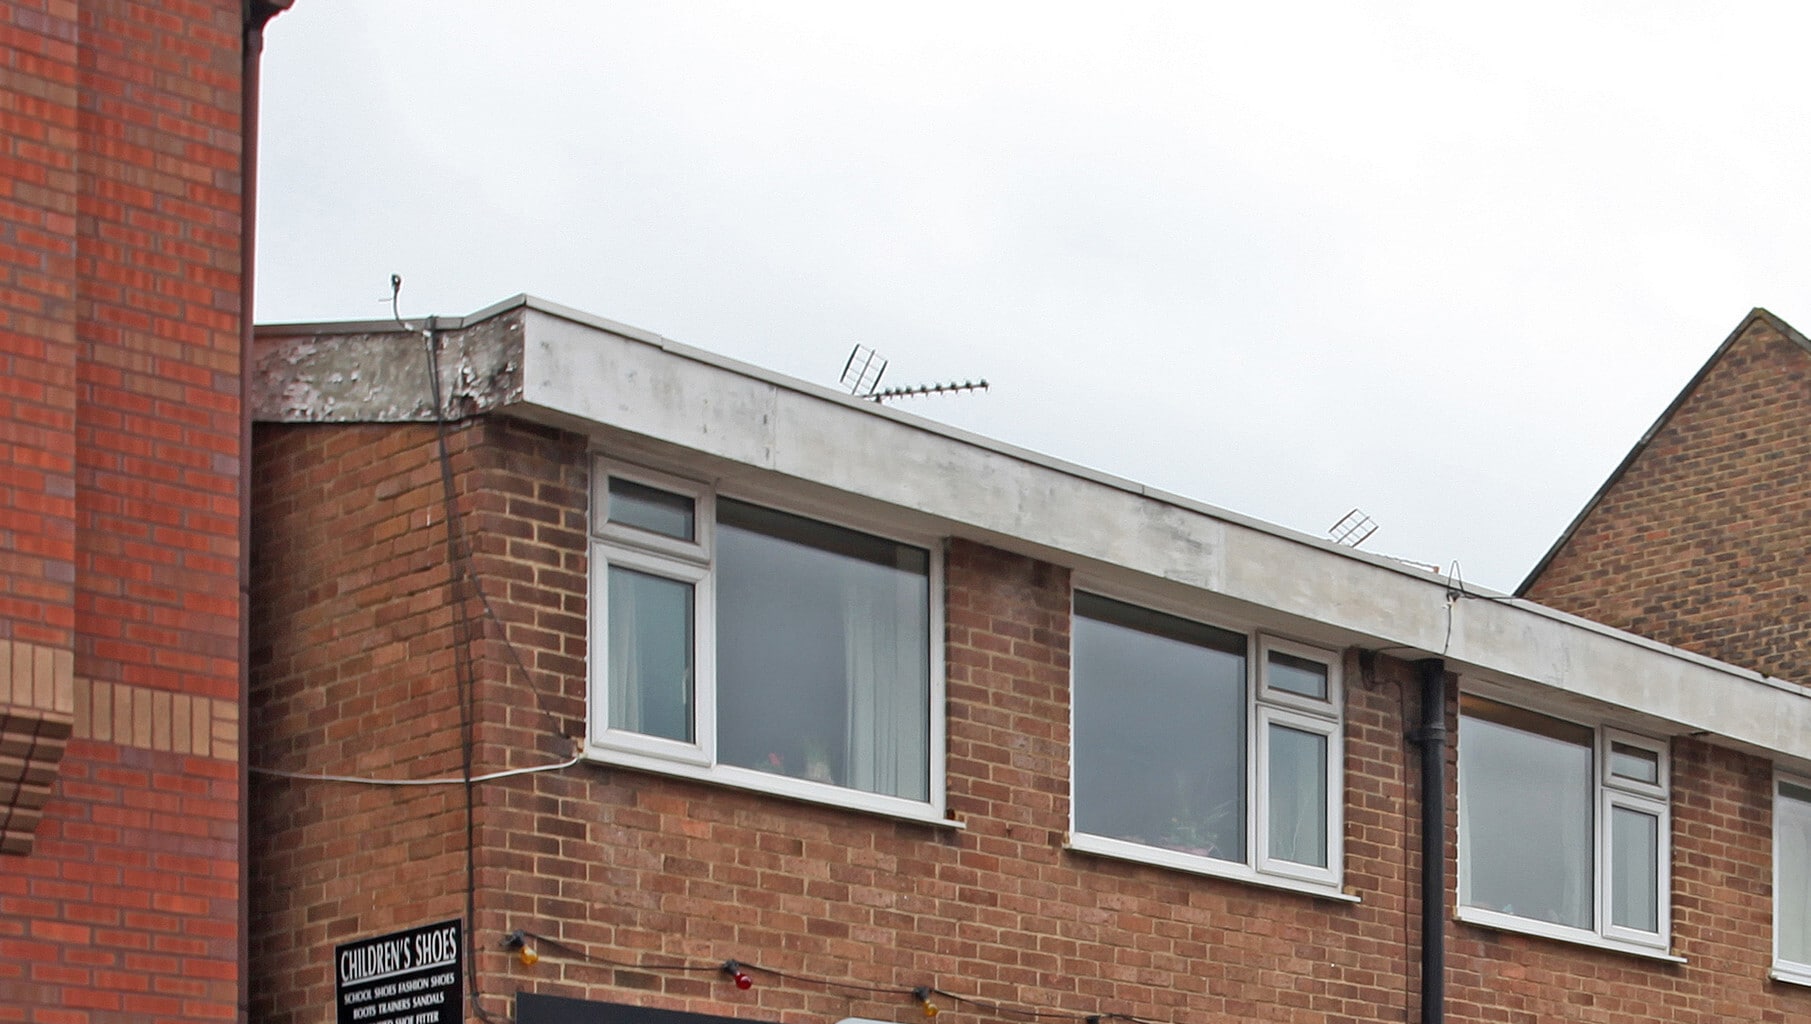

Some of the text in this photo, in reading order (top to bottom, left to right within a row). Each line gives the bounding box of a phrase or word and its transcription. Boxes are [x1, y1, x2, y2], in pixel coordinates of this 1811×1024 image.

[341, 927, 457, 982] CHILDREN'S SHOES
[344, 972, 455, 1005] SCHOOL SHOES FASHION SHOES
[353, 991, 445, 1020] BOOTS TRAINERS SANDALS
[416, 1011, 439, 1024] FITTER
